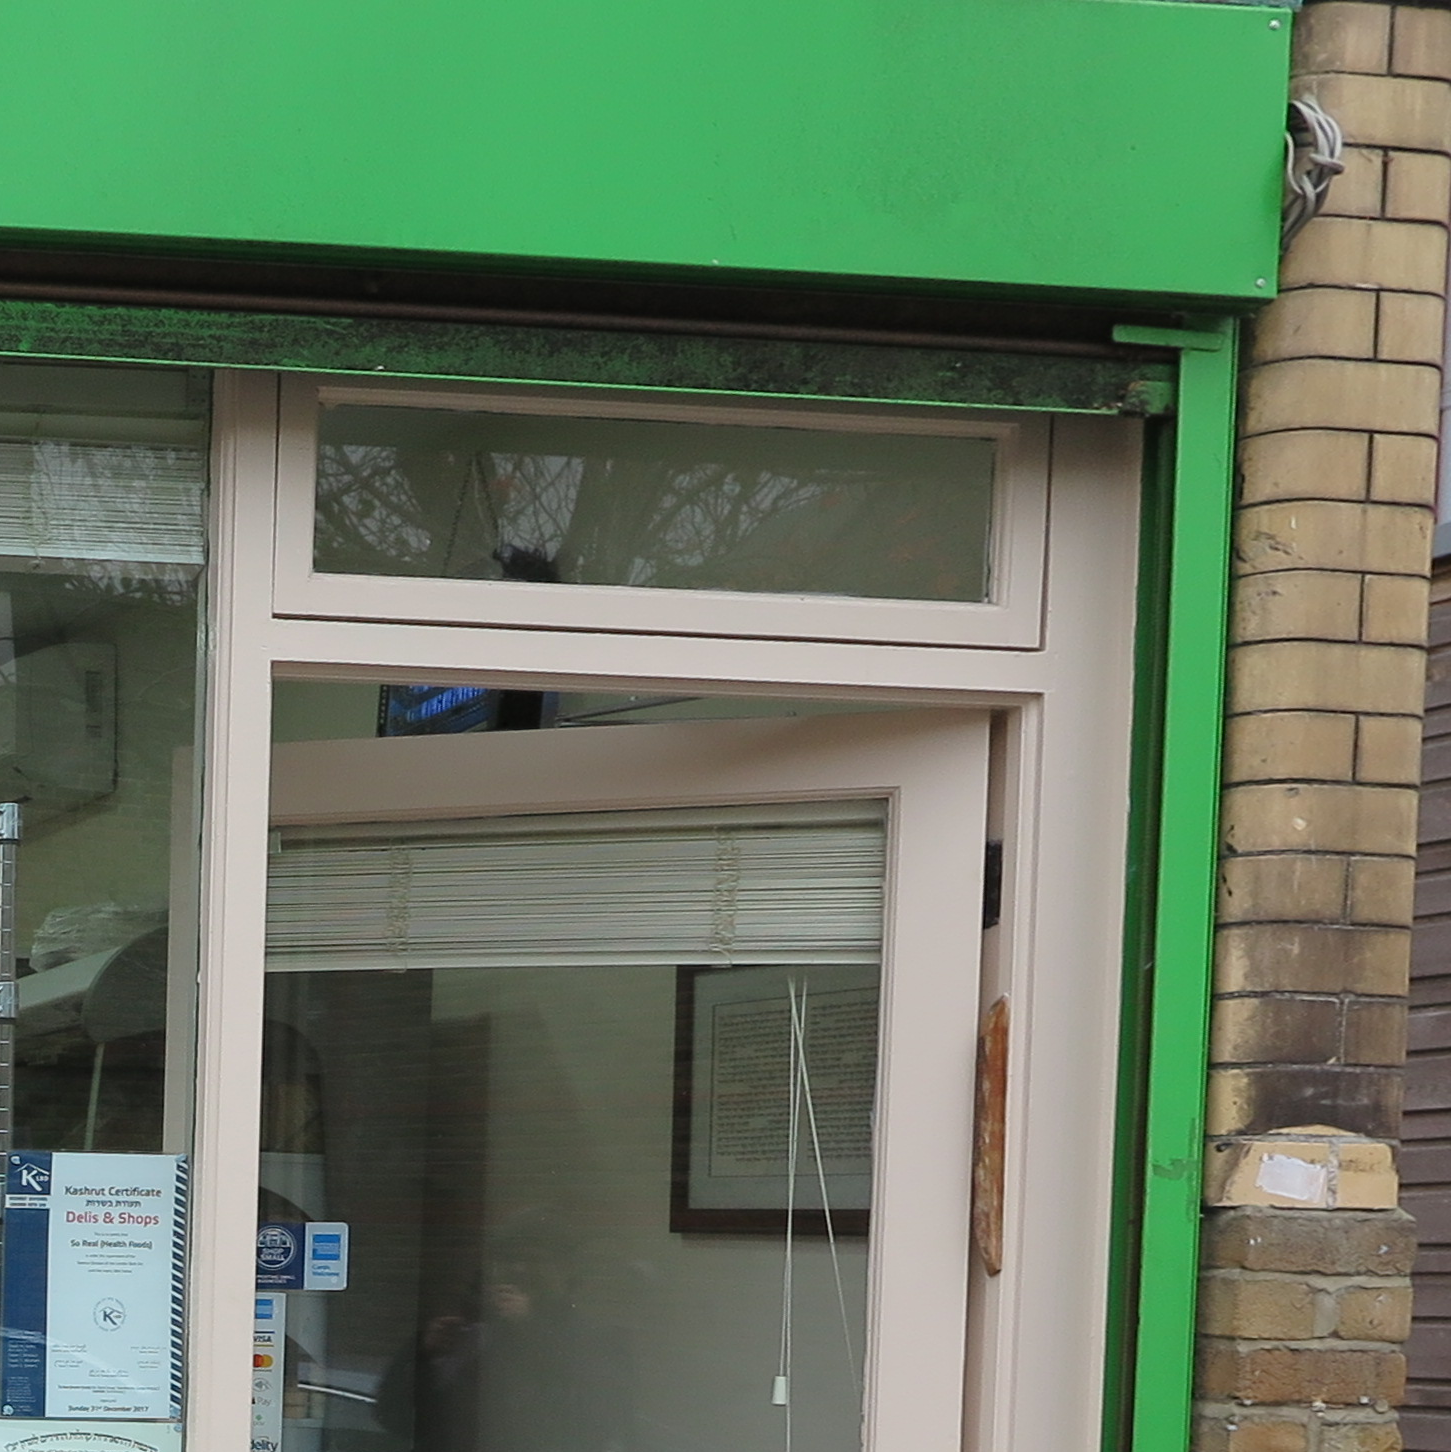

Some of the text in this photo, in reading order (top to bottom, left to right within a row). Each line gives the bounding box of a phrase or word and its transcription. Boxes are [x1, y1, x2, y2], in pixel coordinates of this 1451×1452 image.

[64, 1185, 162, 1197] Kashrut Certificate
[66, 1210, 159, 1227] Delis & Shops
[70, 1239, 80, 1247] So
[82, 1239, 98, 1247] Real
